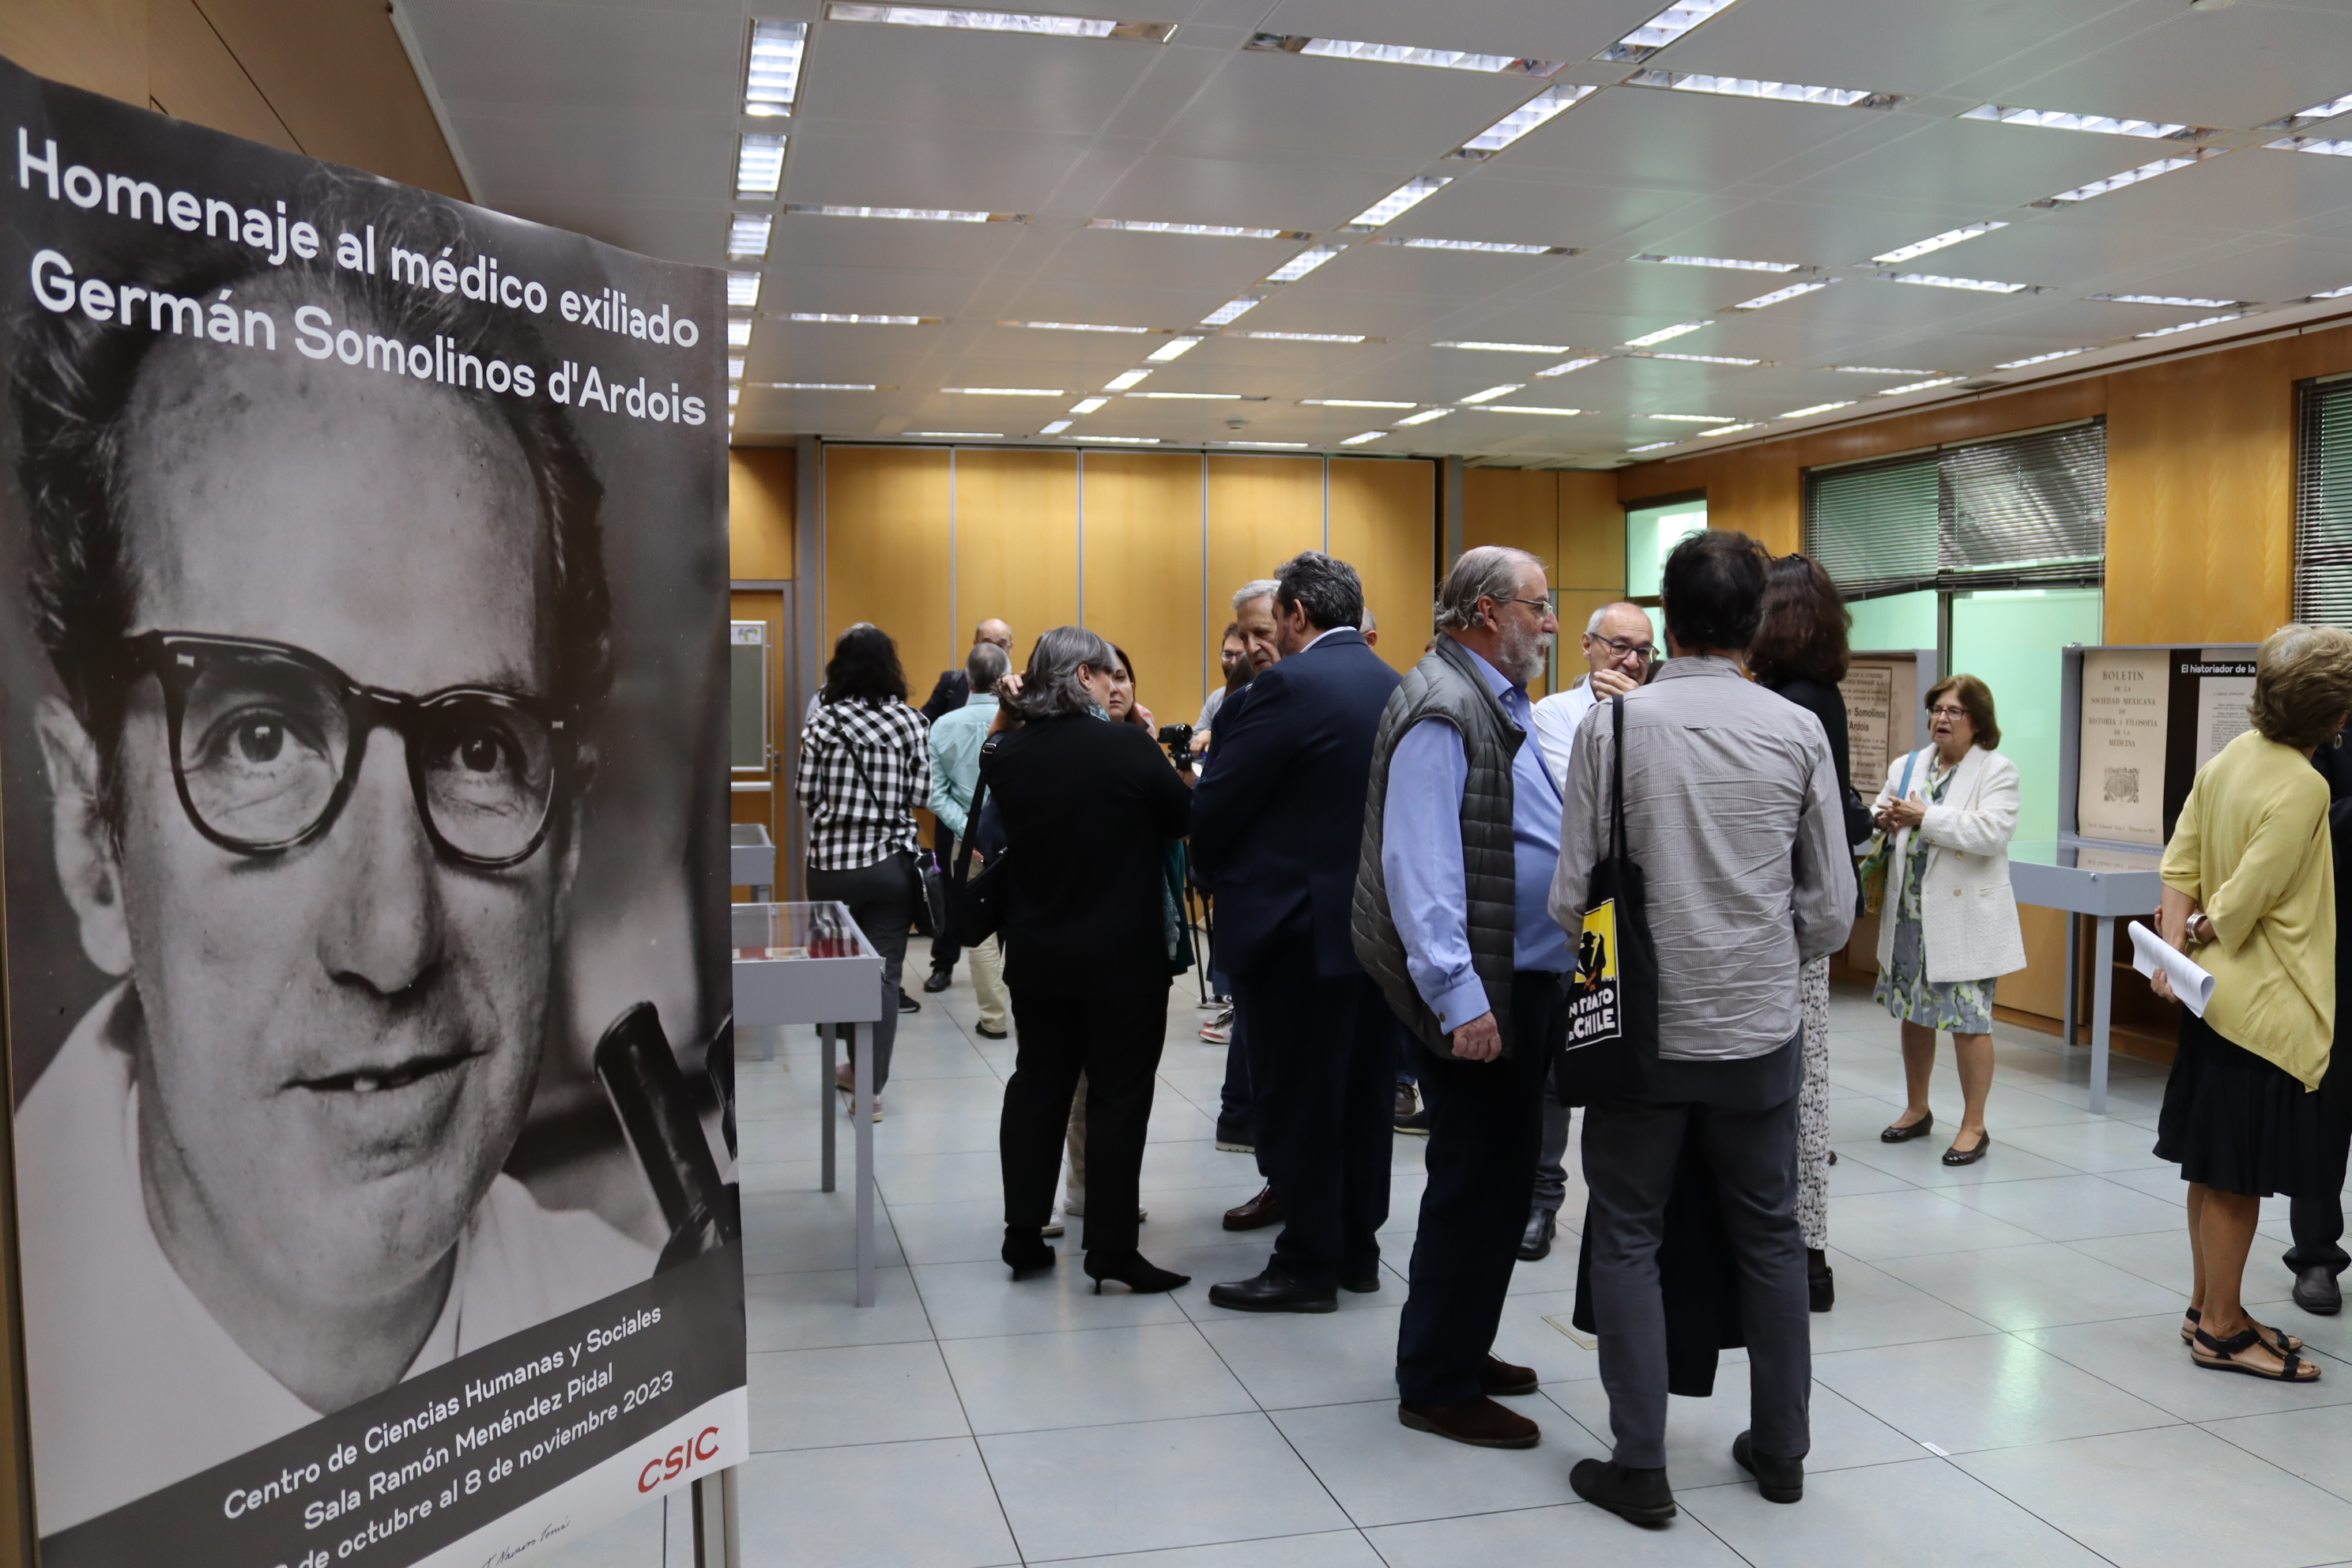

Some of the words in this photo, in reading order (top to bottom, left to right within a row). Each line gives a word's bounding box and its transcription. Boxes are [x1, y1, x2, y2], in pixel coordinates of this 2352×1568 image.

[20, 129, 319, 265] Homenaje
[337, 224, 375, 274] al
[391, 247, 548, 313] médico
[560, 290, 699, 347] exiliado
[32, 250, 275, 350] Germán
[295, 306, 535, 397] Somolinos
[548, 360, 706, 425] d'Ardois
[2102, 670, 2144, 680] BOLETIN
[2180, 664, 2189, 673] El
[2190, 664, 2233, 673] historiador
[2235, 664, 2246, 673] de
[2248, 664, 2256, 673] la
[1854, 707, 1886, 718] Somolinos
[2089, 717, 2117, 726] HISTORIA
[2125, 718, 2158, 727] FILOSOFIA
[2123, 697, 2157, 706] MEXICANA
[1574, 1008, 1616, 1039] CHILE
[224, 1463, 320, 1519] Centro
[328, 1443, 358, 1472] de
[364, 1397, 460, 1454] Ciencias
[465, 1351, 564, 1408] Humanas
[568, 1342, 582, 1367] y
[586, 1307, 662, 1352] Sociales
[299, 1550, 330, 1568] de
[337, 1500, 432, 1559] octubre
[439, 1479, 458, 1509] al
[465, 1469, 481, 1494] 8
[488, 1457, 514, 1483] de
[519, 1404, 618, 1468] noviembre
[623, 1370, 673, 1413] 2023
[304, 1489, 361, 1531] Sala
[369, 1447, 449, 1501] Ramón
[455, 1393, 563, 1457] Menéndez
[567, 1362, 613, 1404] Pidal
[639, 1427, 720, 1494] CSIC
